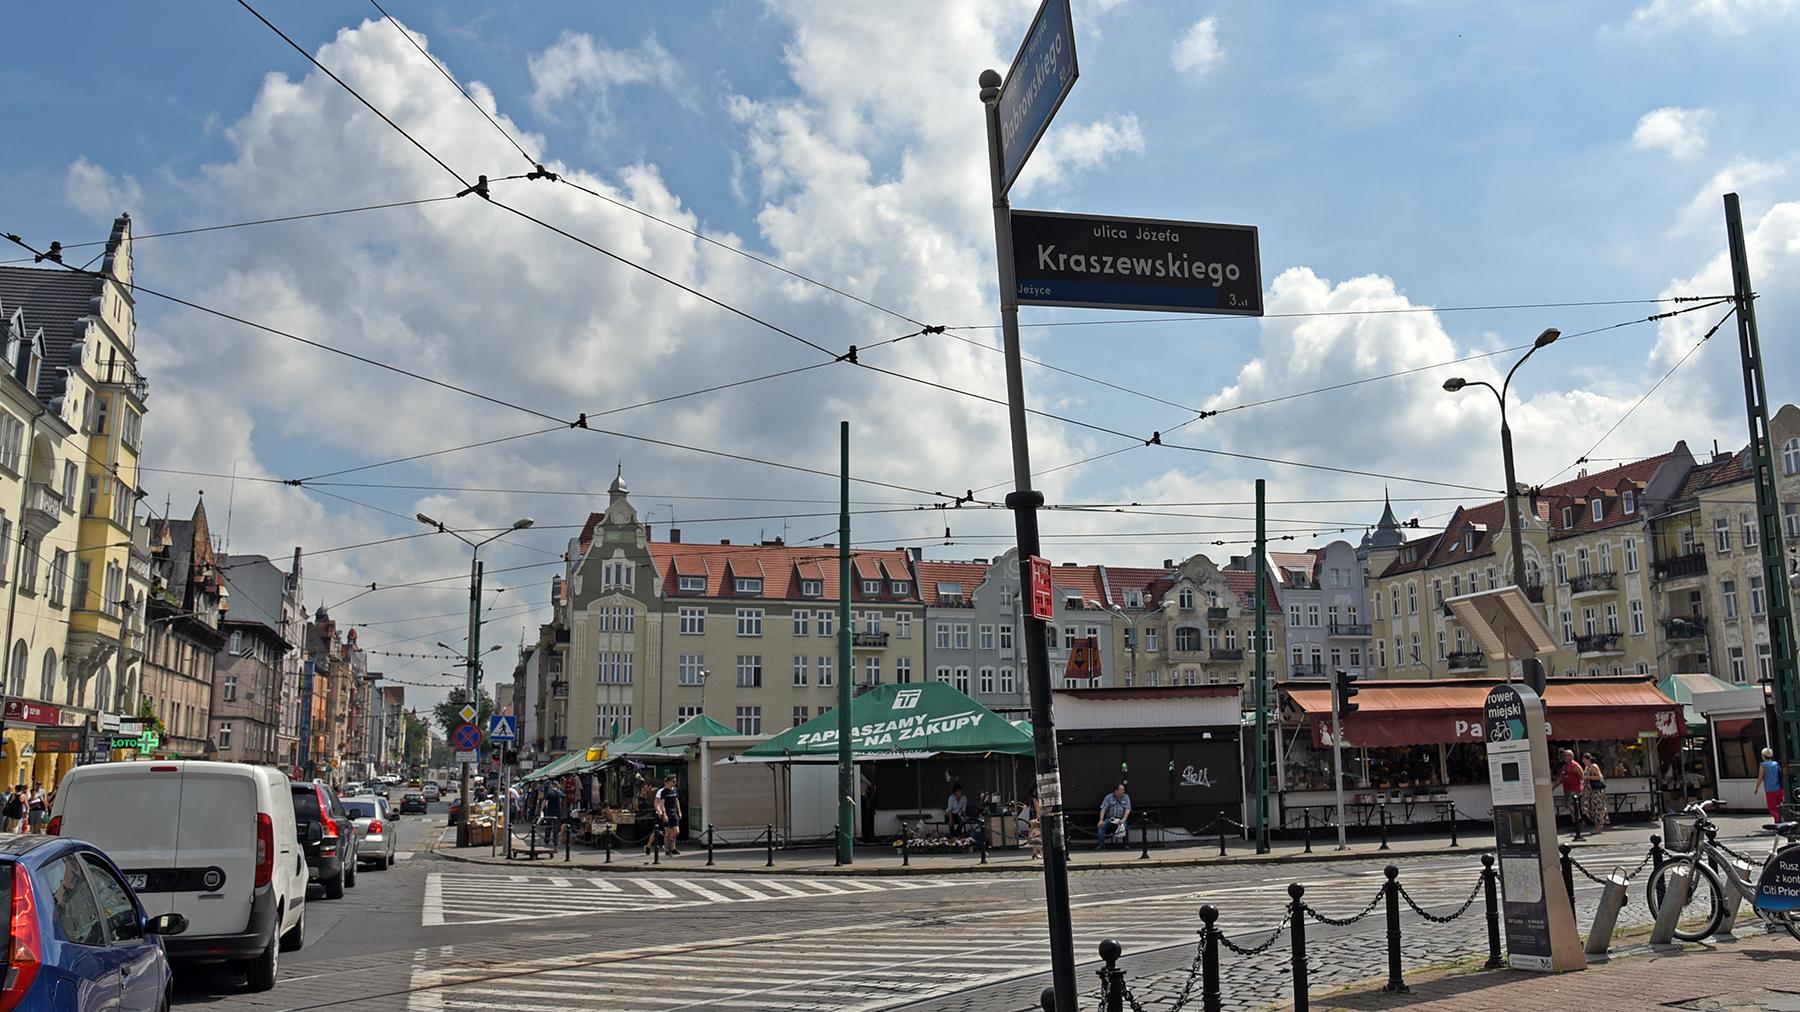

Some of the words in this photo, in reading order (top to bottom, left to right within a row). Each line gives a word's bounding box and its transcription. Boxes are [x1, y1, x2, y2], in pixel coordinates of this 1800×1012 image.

[1002, 32, 1062, 150] Dąbrowskiego
[1093, 225, 1128, 240] ulica
[1135, 227, 1180, 243] Józefa
[1037, 244, 1240, 288] Kraszewskiego
[1018, 285, 1052, 297] Jeżyce
[1487, 692, 1514, 704] rower
[1487, 702, 1522, 719] miejski
[797, 713, 928, 745] ZAPASZAMY
[863, 732, 893, 747] NA
[898, 713, 985, 741] ZAKUPY
[1780, 861, 1799, 871] Rusz
[1775, 874, 1781, 883] z
[1763, 885, 1777, 895] Citi
[1778, 886, 1800, 896] Prior
